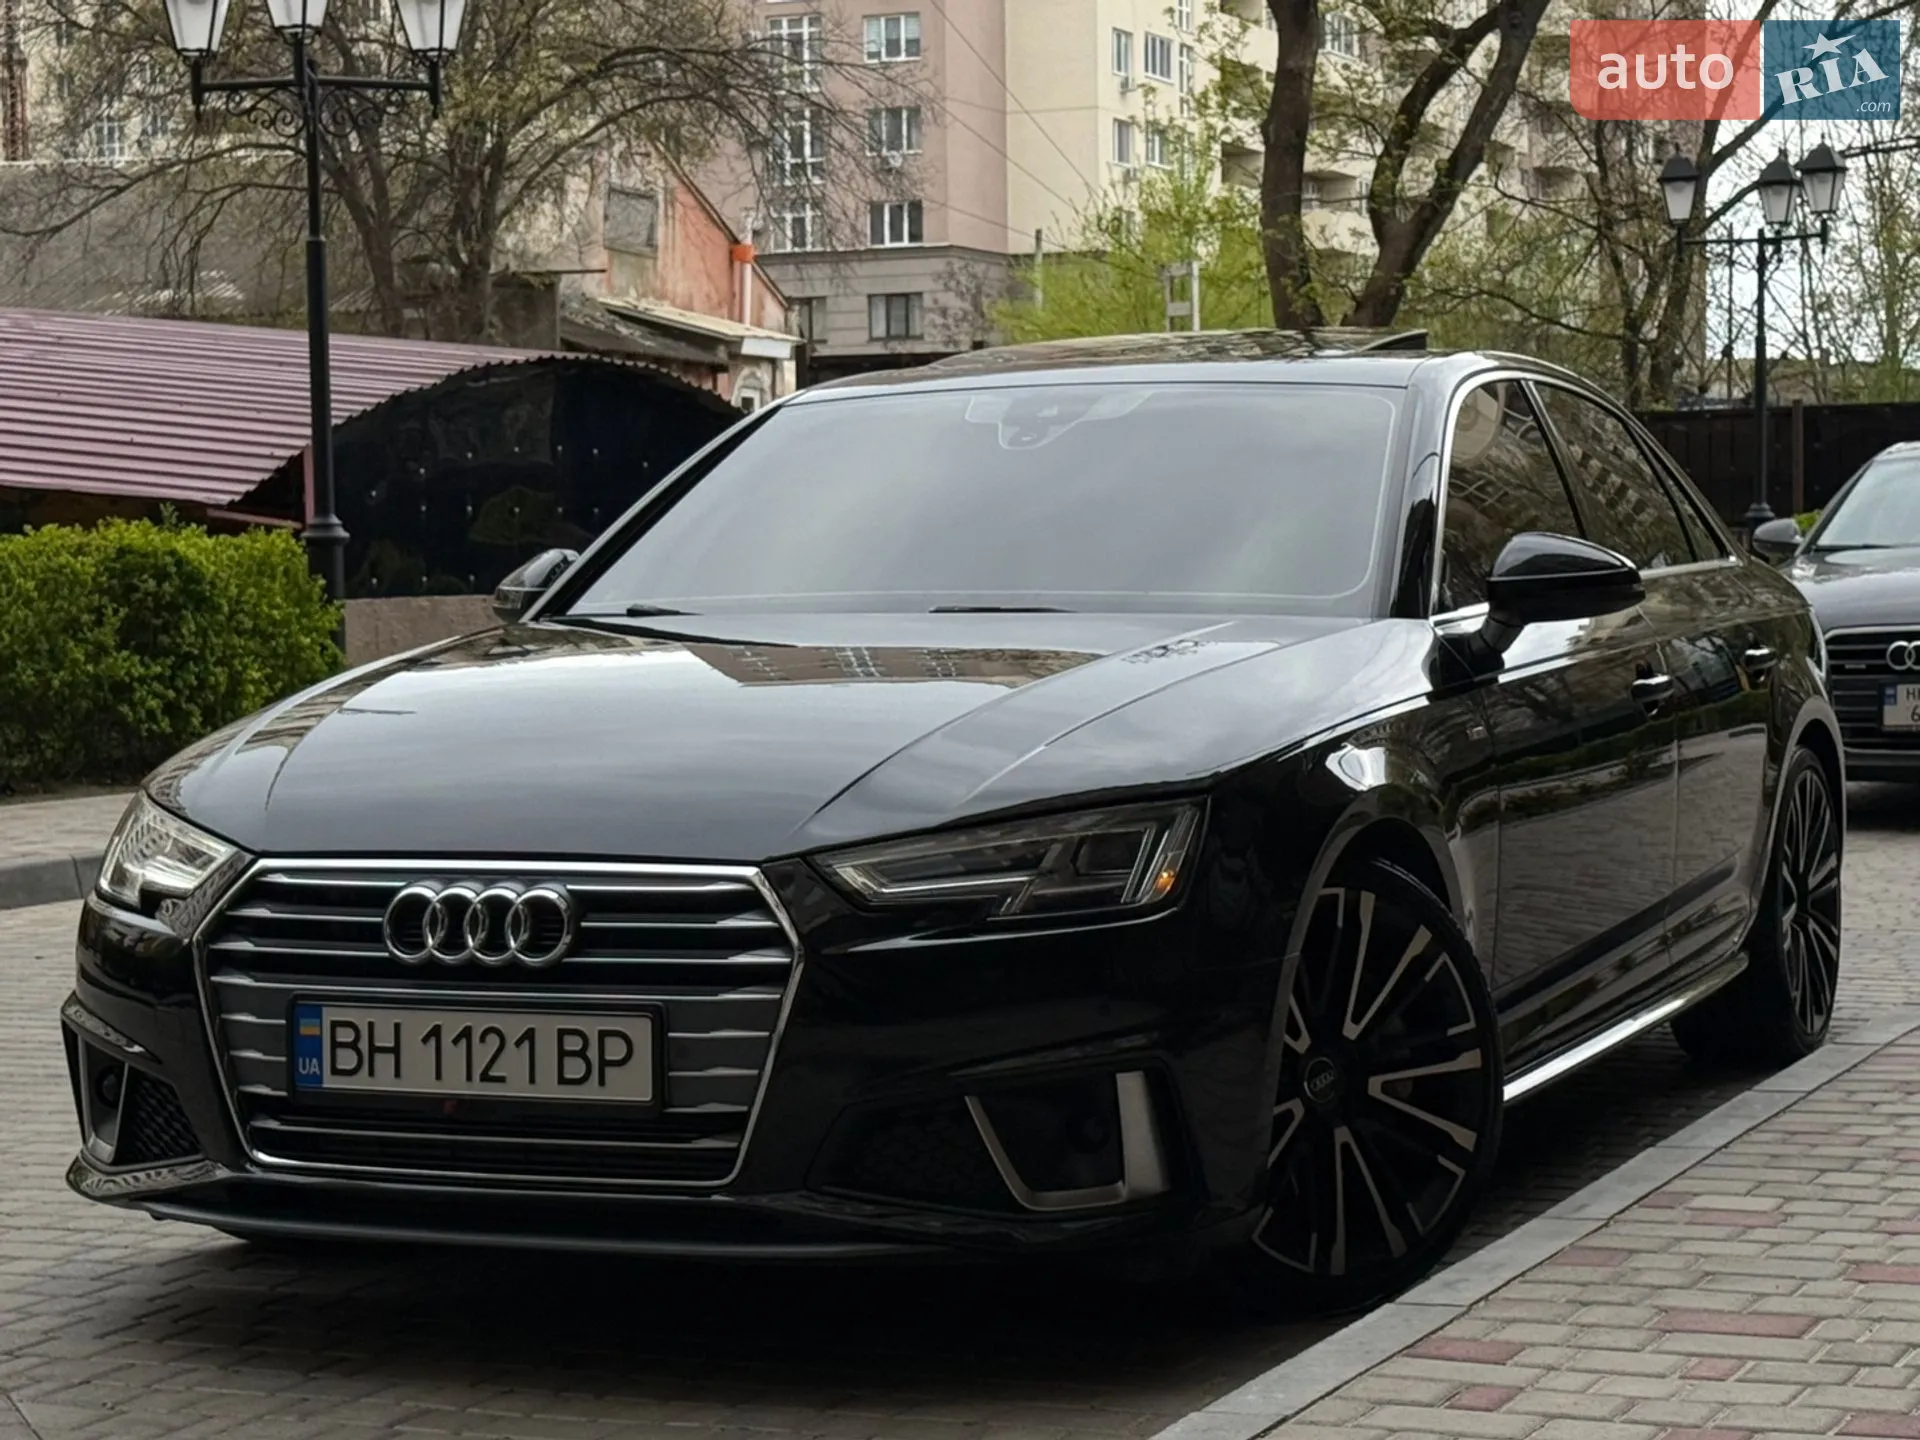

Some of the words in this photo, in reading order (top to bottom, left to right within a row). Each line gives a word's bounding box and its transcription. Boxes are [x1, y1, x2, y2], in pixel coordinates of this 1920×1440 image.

[298, 1057, 320, 1076] UA
[328, 1019, 402, 1079] BH
[420, 1022, 536, 1085] 1121
[556, 1027, 634, 1088] BP
